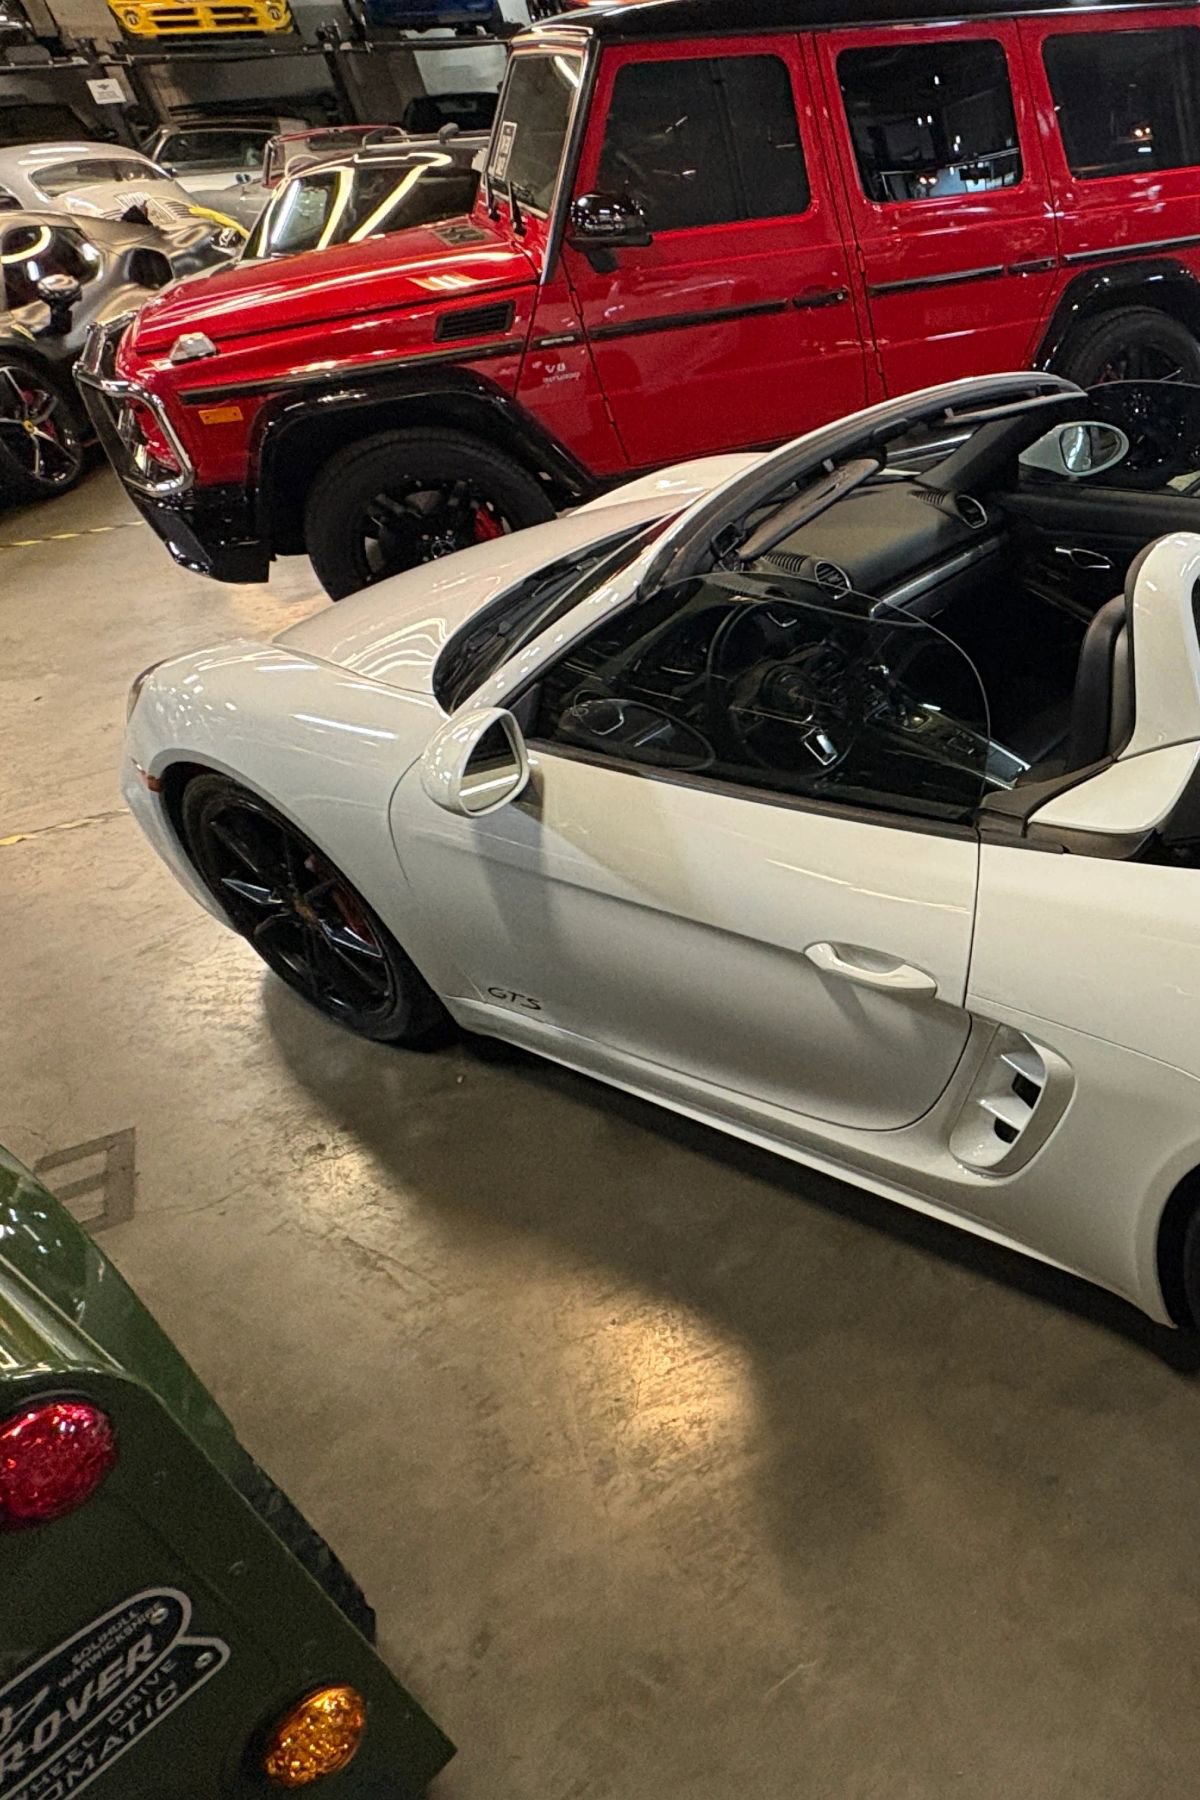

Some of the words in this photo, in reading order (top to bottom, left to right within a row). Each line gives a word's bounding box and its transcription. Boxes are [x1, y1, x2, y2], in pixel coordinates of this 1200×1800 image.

[544, 362, 566, 374] V8
[488, 986, 542, 1011] GTS
[0, 1633, 156, 1783] ROVER
[108, 1658, 178, 1726] DRIVE
